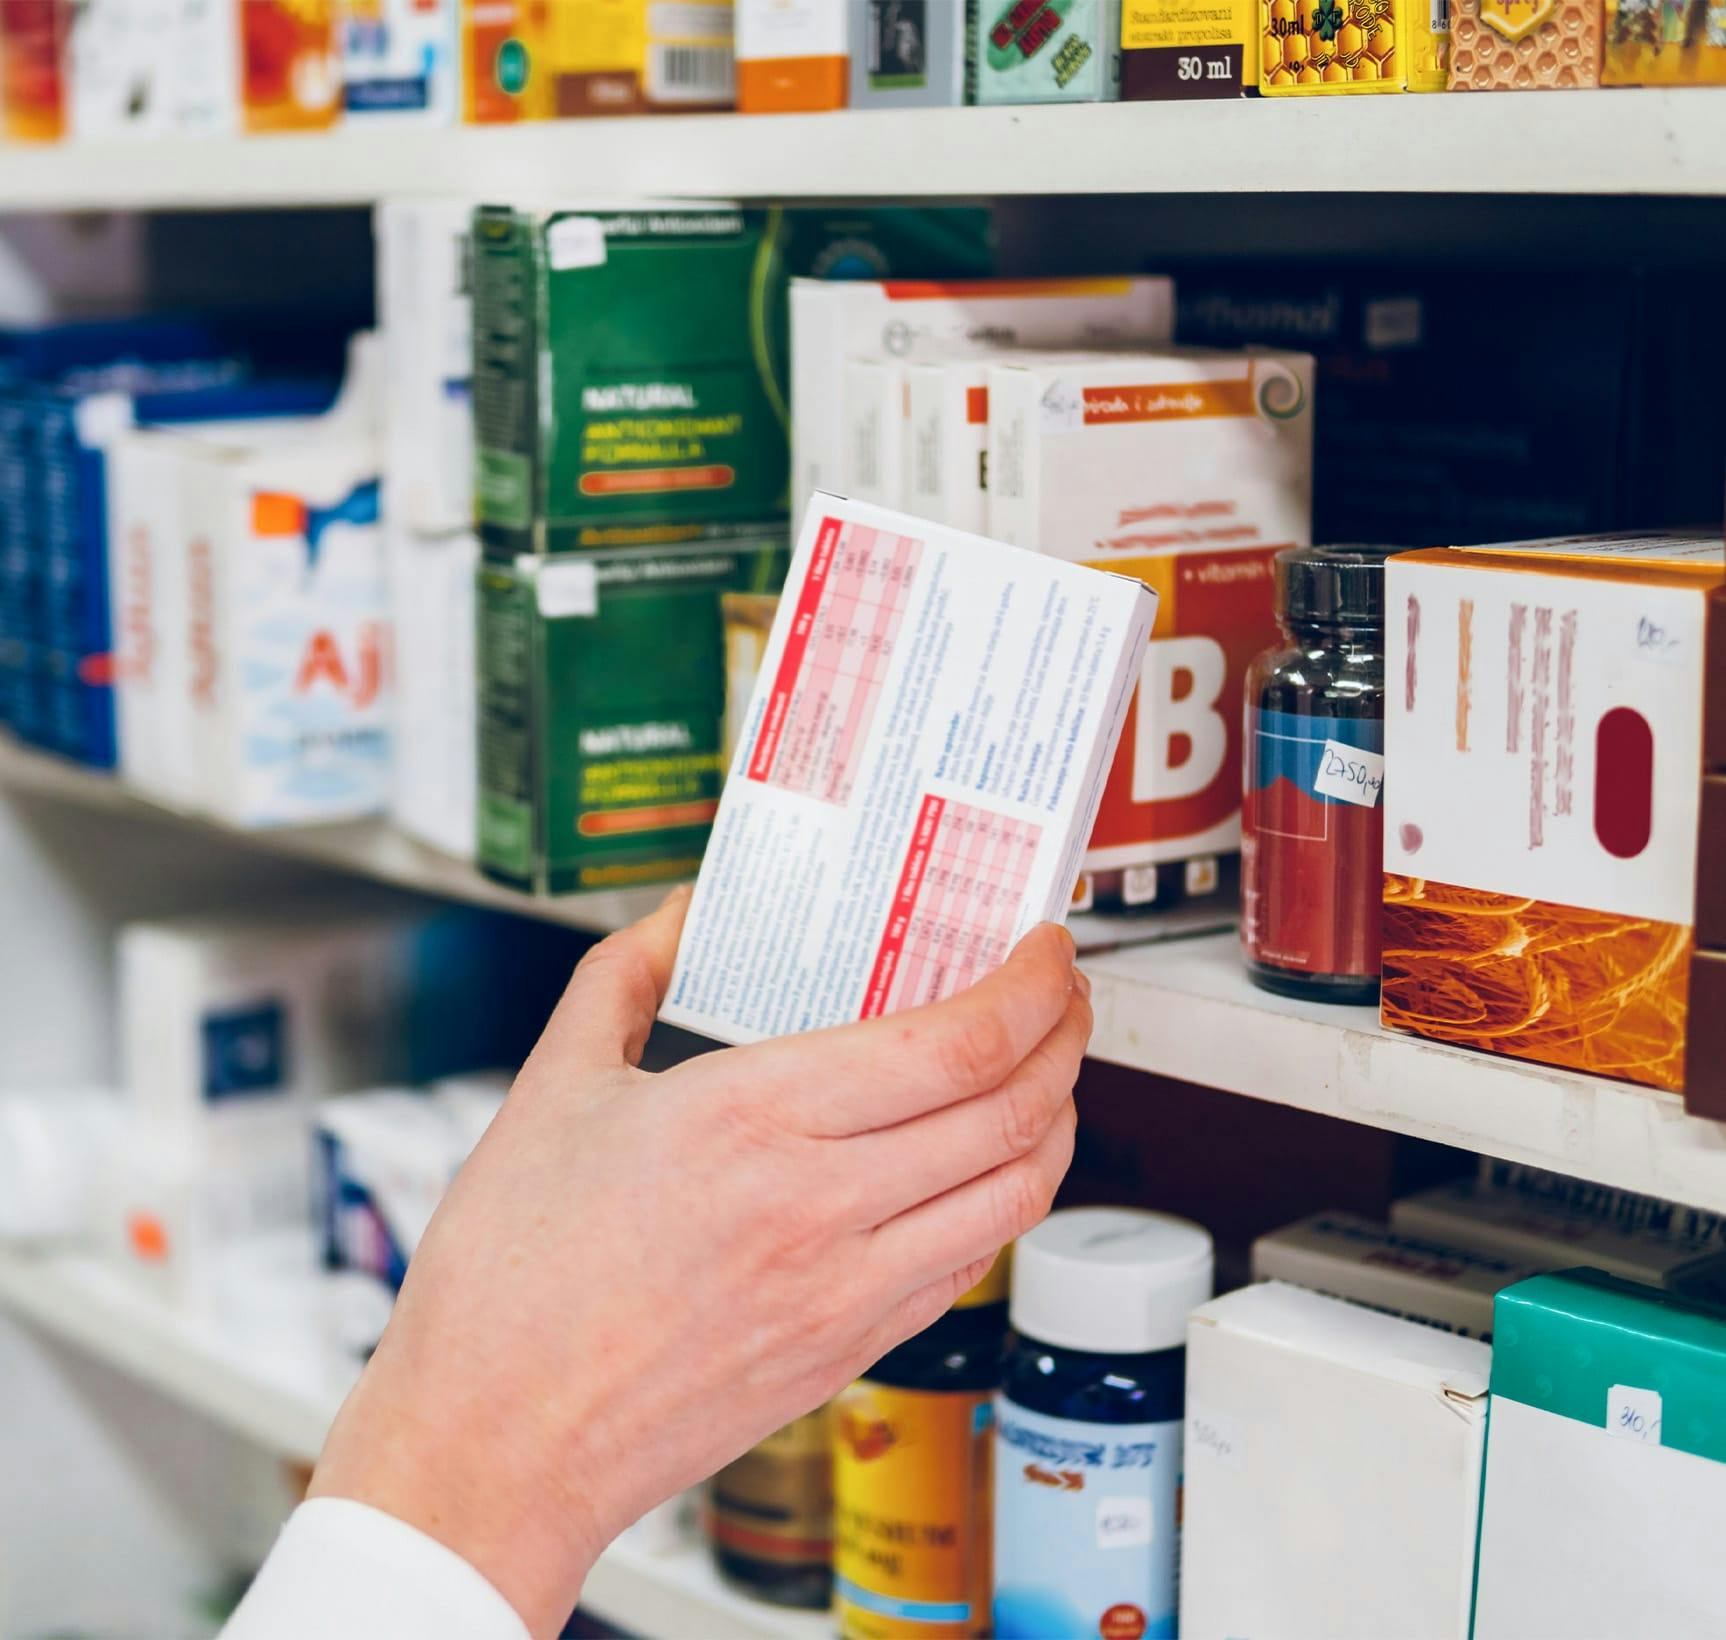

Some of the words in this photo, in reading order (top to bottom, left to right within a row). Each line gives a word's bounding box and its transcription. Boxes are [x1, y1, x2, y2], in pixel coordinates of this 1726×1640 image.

[1270, 14, 1305, 37] 30ml
[1177, 56, 1203, 81] 30
[1206, 56, 1233, 80] ml
[1131, 635, 1228, 804] B
